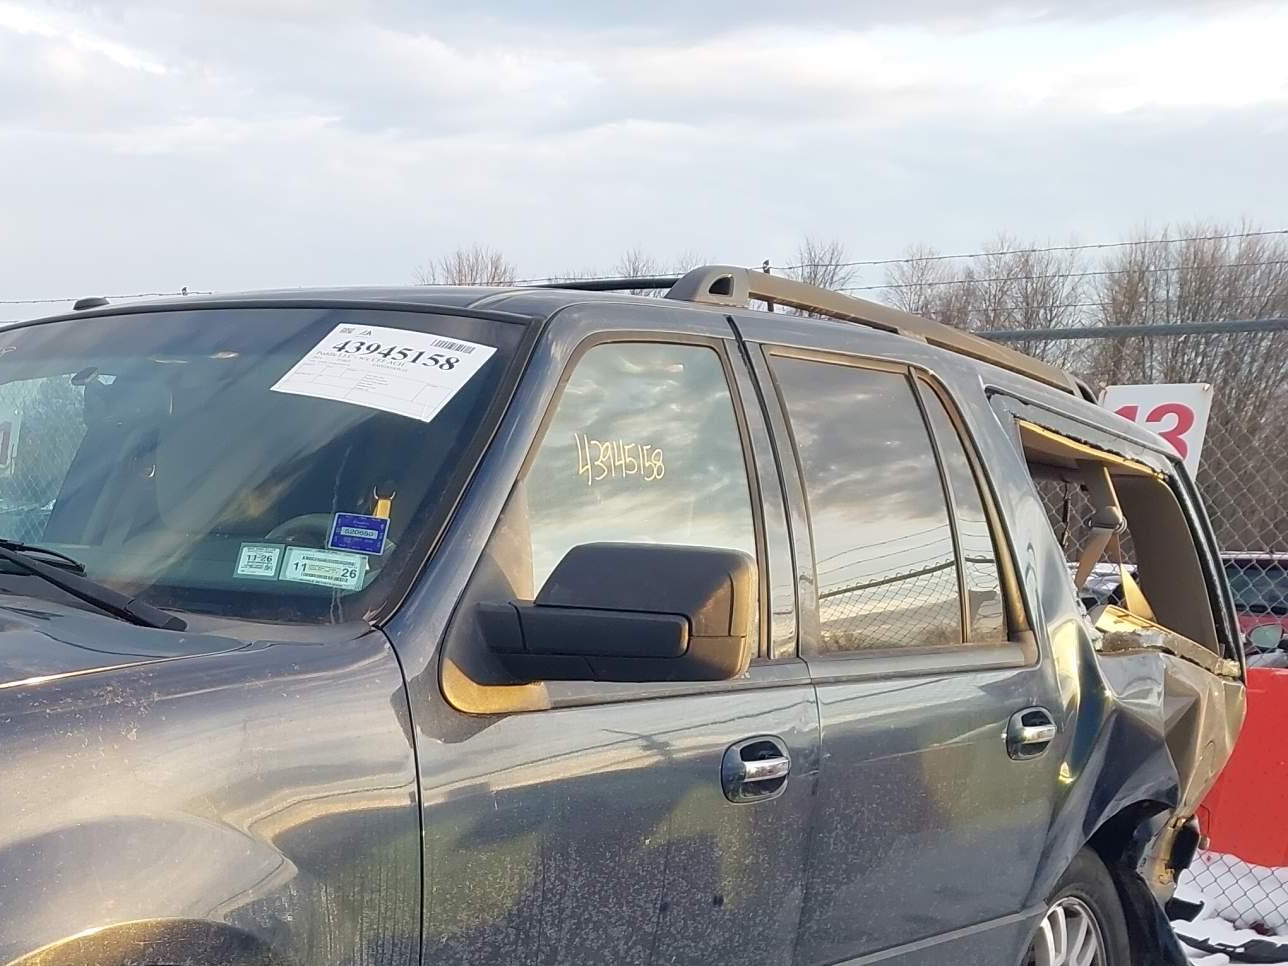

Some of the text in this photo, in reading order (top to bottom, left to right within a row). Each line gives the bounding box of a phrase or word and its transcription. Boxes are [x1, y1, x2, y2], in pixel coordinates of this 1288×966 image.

[332, 338, 461, 371] 43945158
[574, 433, 665, 486] 43945158
[341, 567, 357, 579] 26
